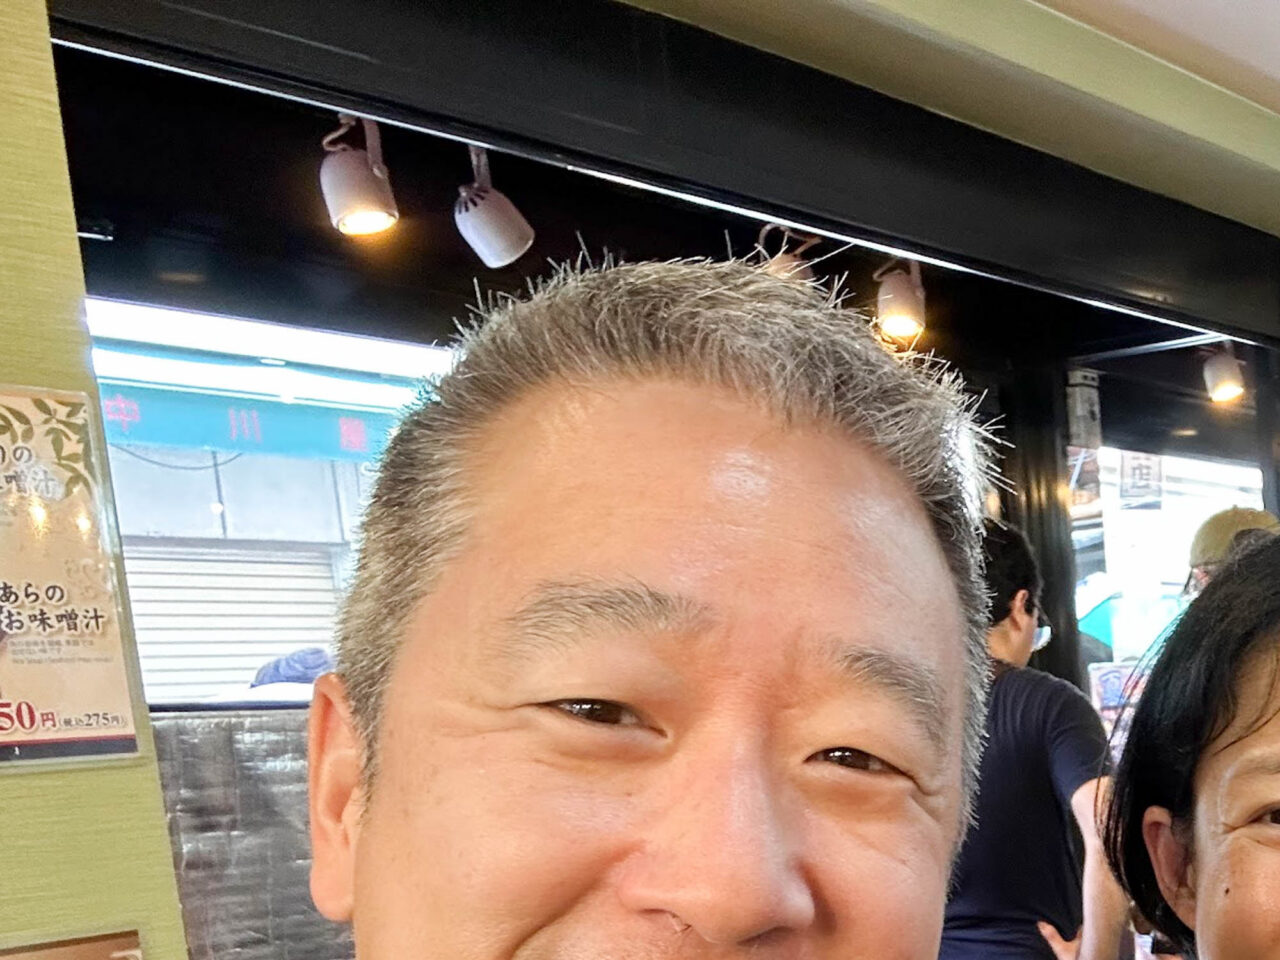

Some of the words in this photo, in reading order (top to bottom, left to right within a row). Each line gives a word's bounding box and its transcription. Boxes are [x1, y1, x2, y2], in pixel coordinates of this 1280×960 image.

[0, 468, 56, 495] 噌汁
[0, 581, 65, 604] あらの
[5, 607, 105, 632] お味噌汁
